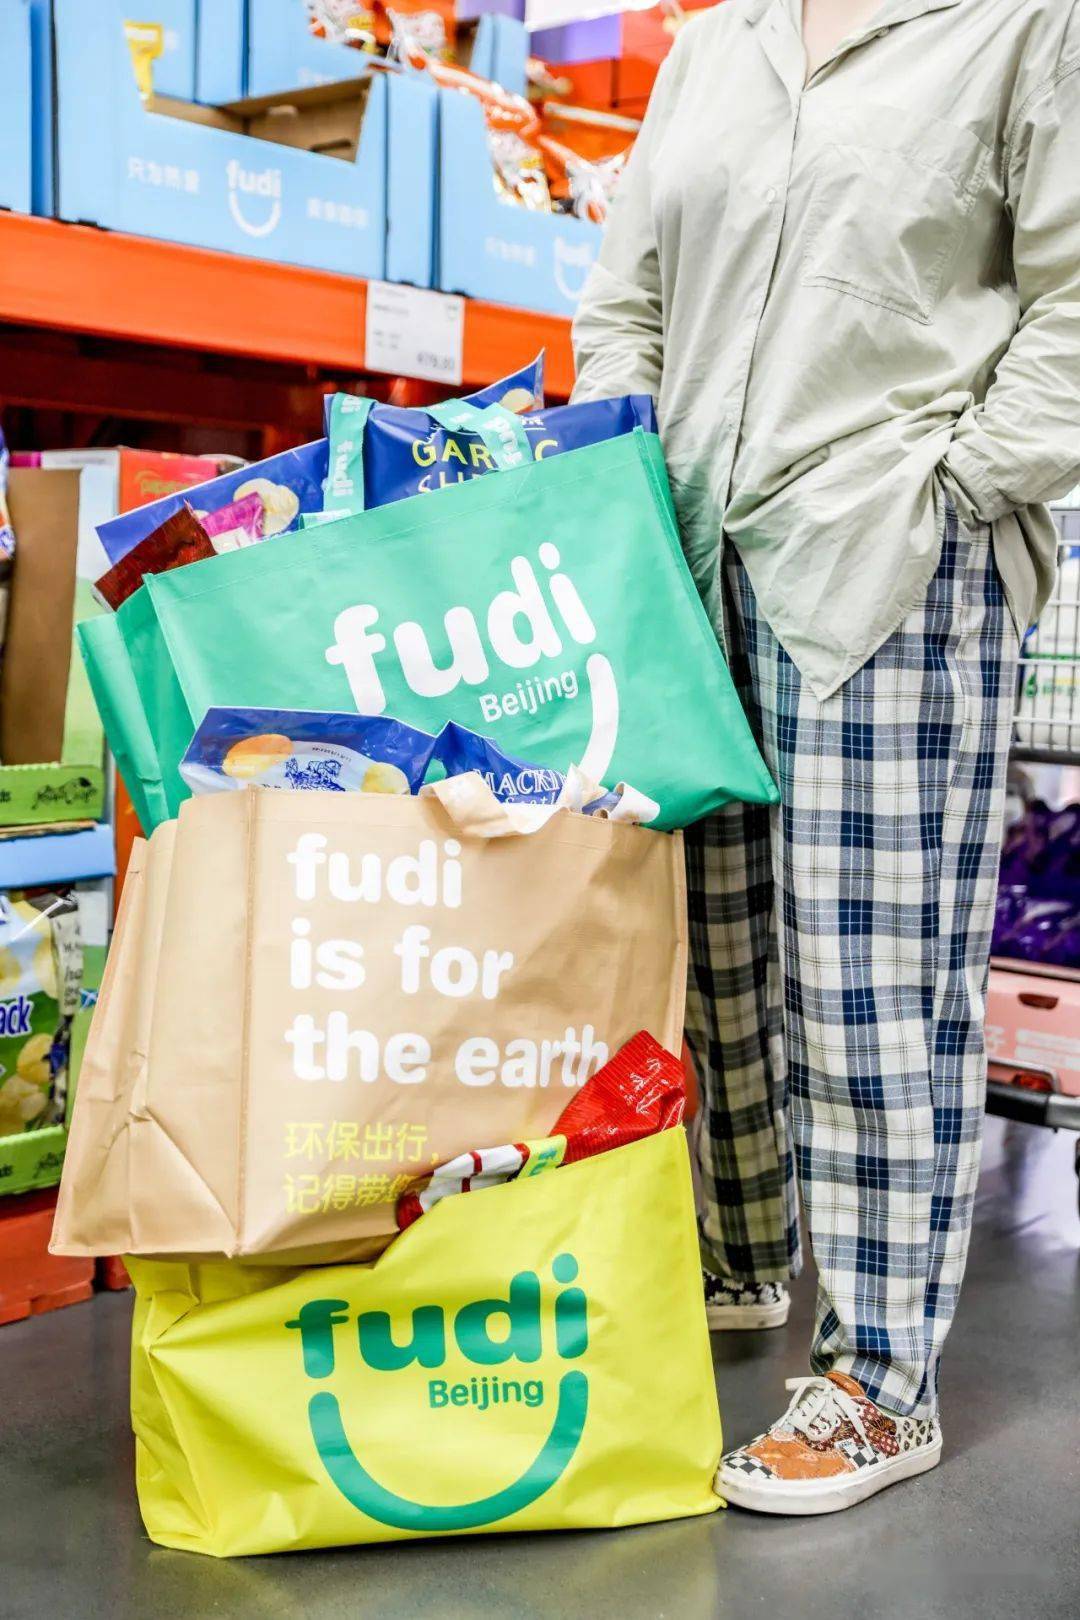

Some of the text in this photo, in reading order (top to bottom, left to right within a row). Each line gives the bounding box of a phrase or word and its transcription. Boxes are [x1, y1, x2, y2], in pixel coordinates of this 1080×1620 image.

[411, 439, 558, 469] GARC
[326, 542, 598, 717] fudi
[479, 669, 579, 723] Beijing
[285, 832, 463, 910] fudi
[289, 917, 515, 1001] is for
[284, 1010, 608, 1088] the earth
[284, 1252, 589, 1380] fudi
[428, 1377, 545, 1412] Beijing
